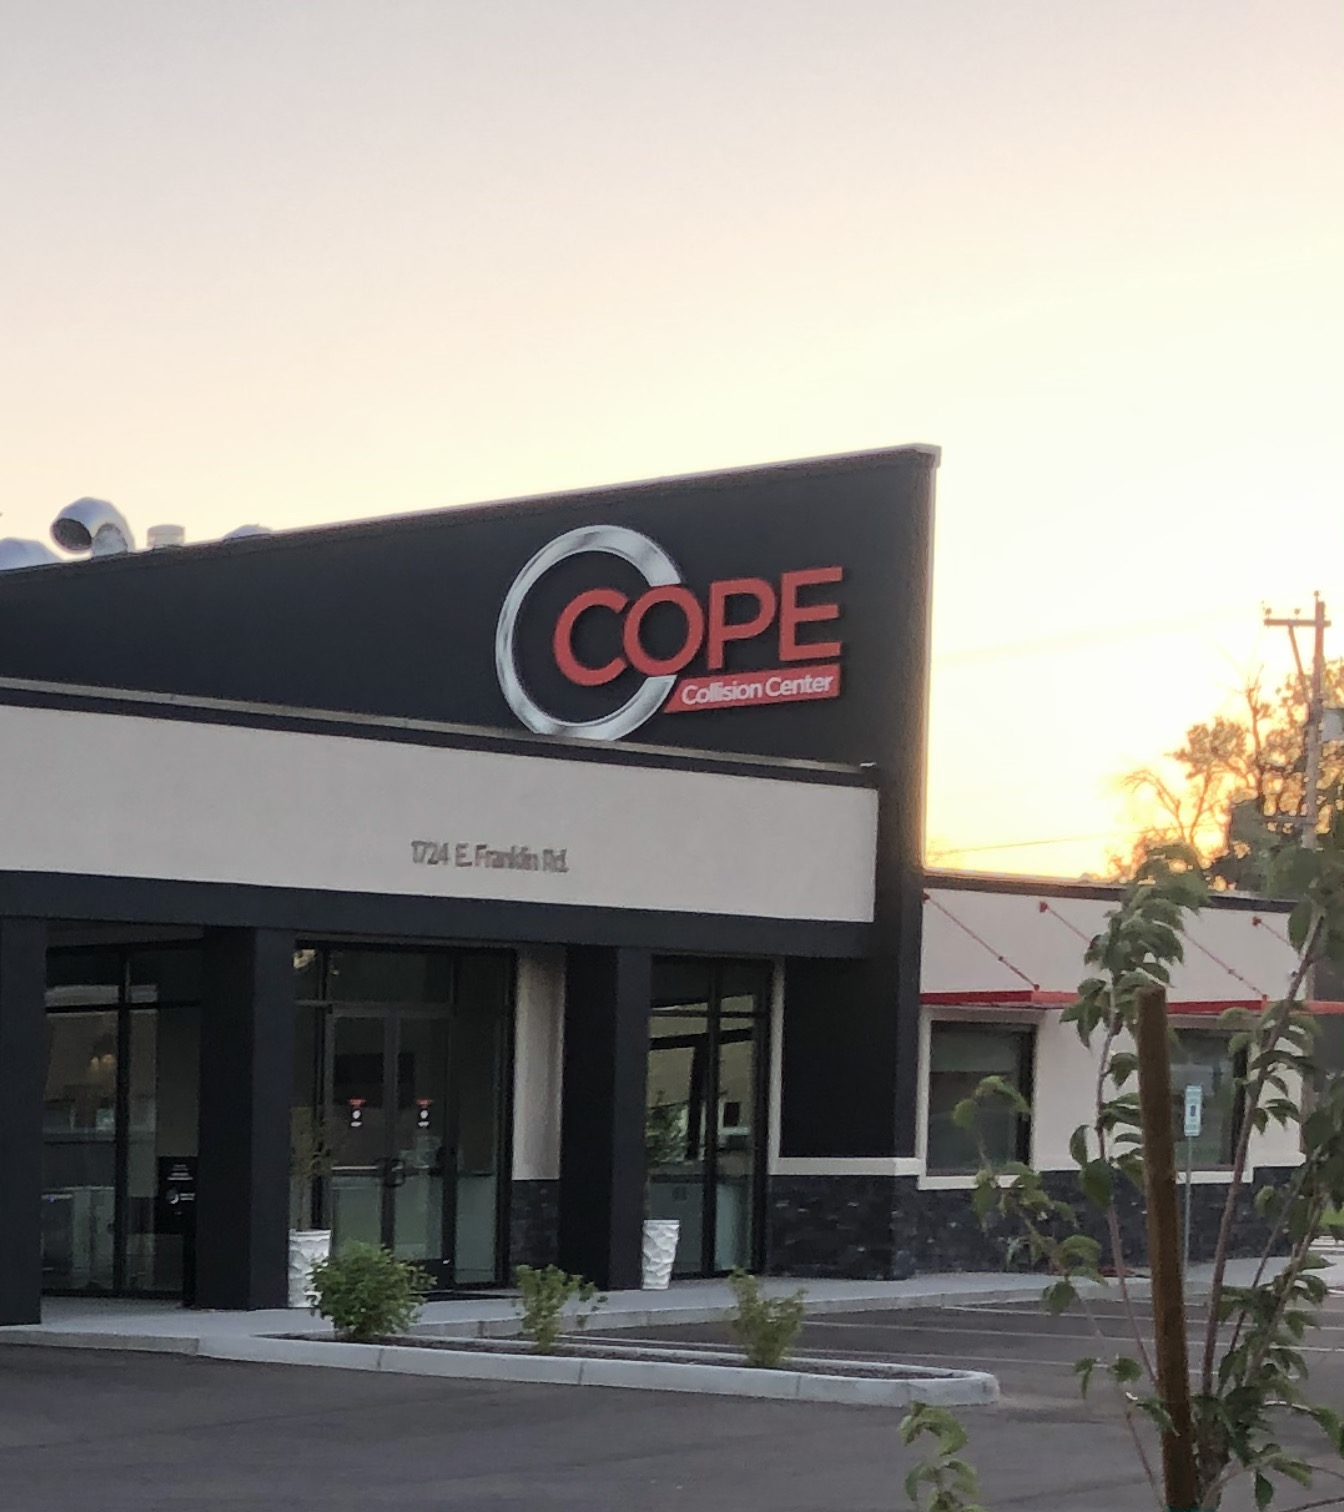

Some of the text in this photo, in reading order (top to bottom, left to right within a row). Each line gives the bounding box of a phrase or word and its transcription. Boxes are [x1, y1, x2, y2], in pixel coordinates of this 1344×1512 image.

[553, 567, 843, 686] COPE
[681, 674, 834, 705] Collision Center
